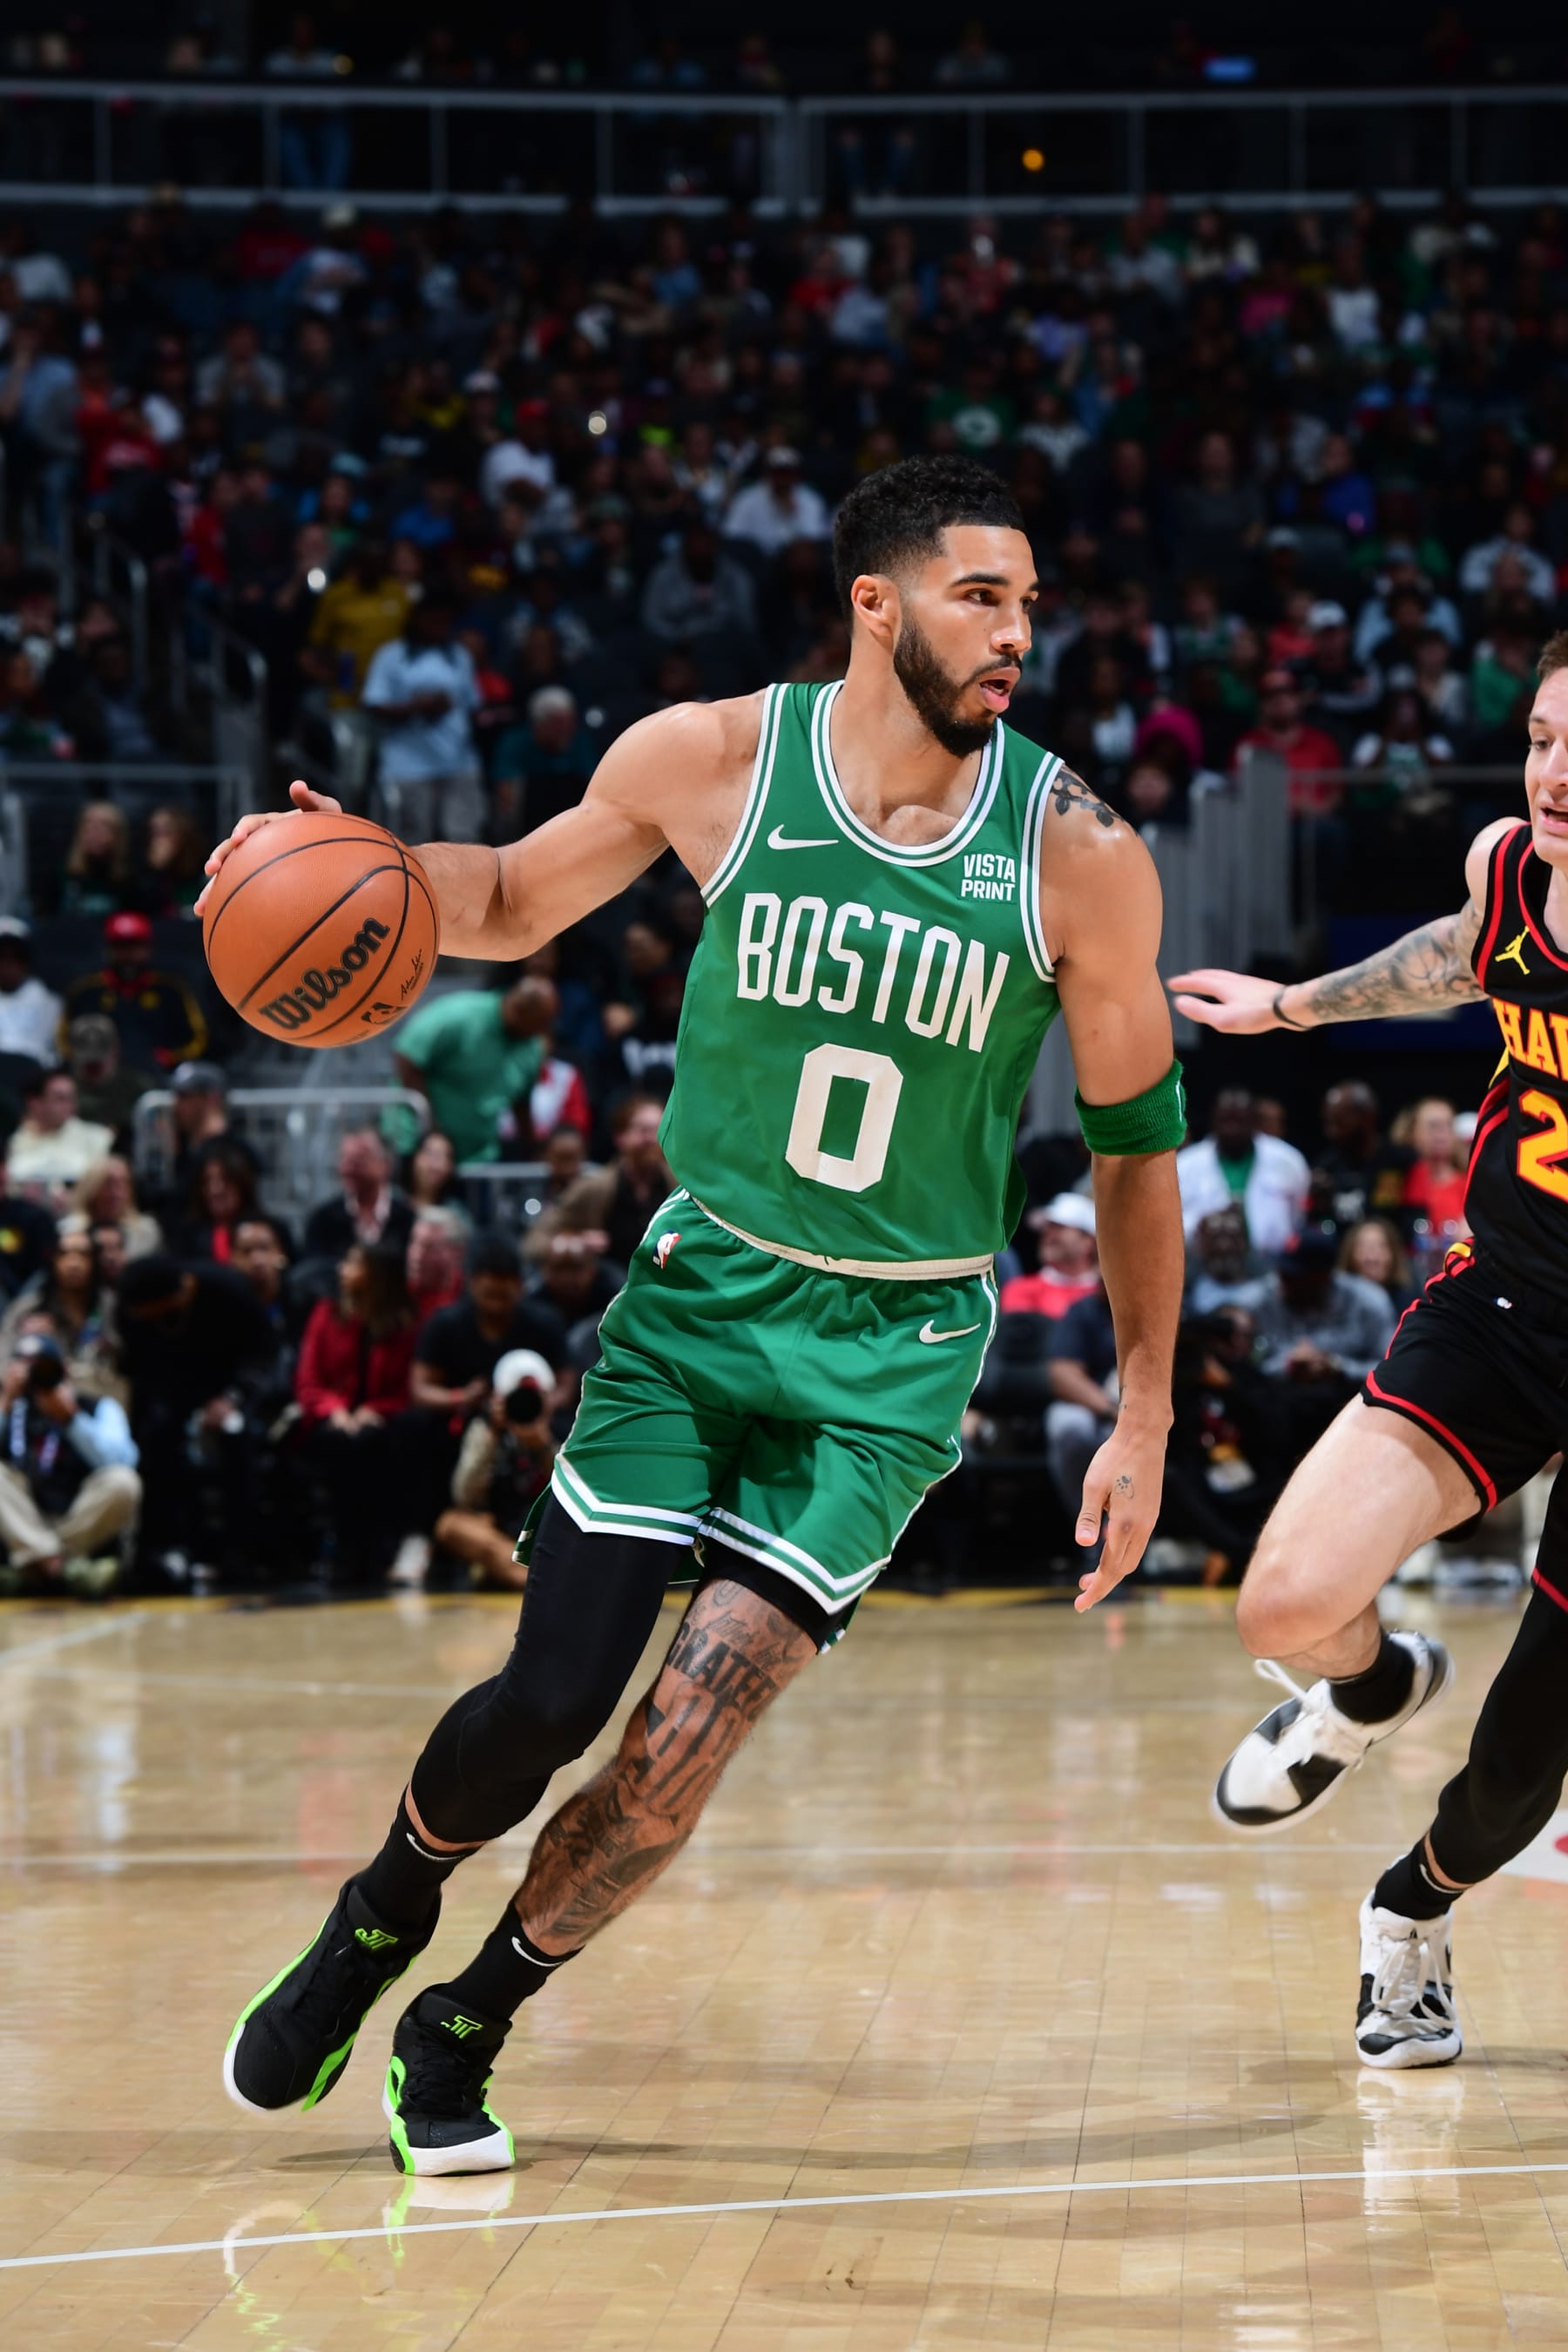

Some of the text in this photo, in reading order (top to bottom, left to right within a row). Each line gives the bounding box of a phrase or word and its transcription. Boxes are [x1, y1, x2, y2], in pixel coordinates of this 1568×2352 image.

[960, 878, 1016, 902] PRINT
[963, 853, 1016, 883] VISTA
[257, 916, 391, 1031] Wilson
[736, 892, 1010, 1053] BOSTON
[785, 1043, 904, 1193] 0
[1516, 1087, 1568, 1203] 2
